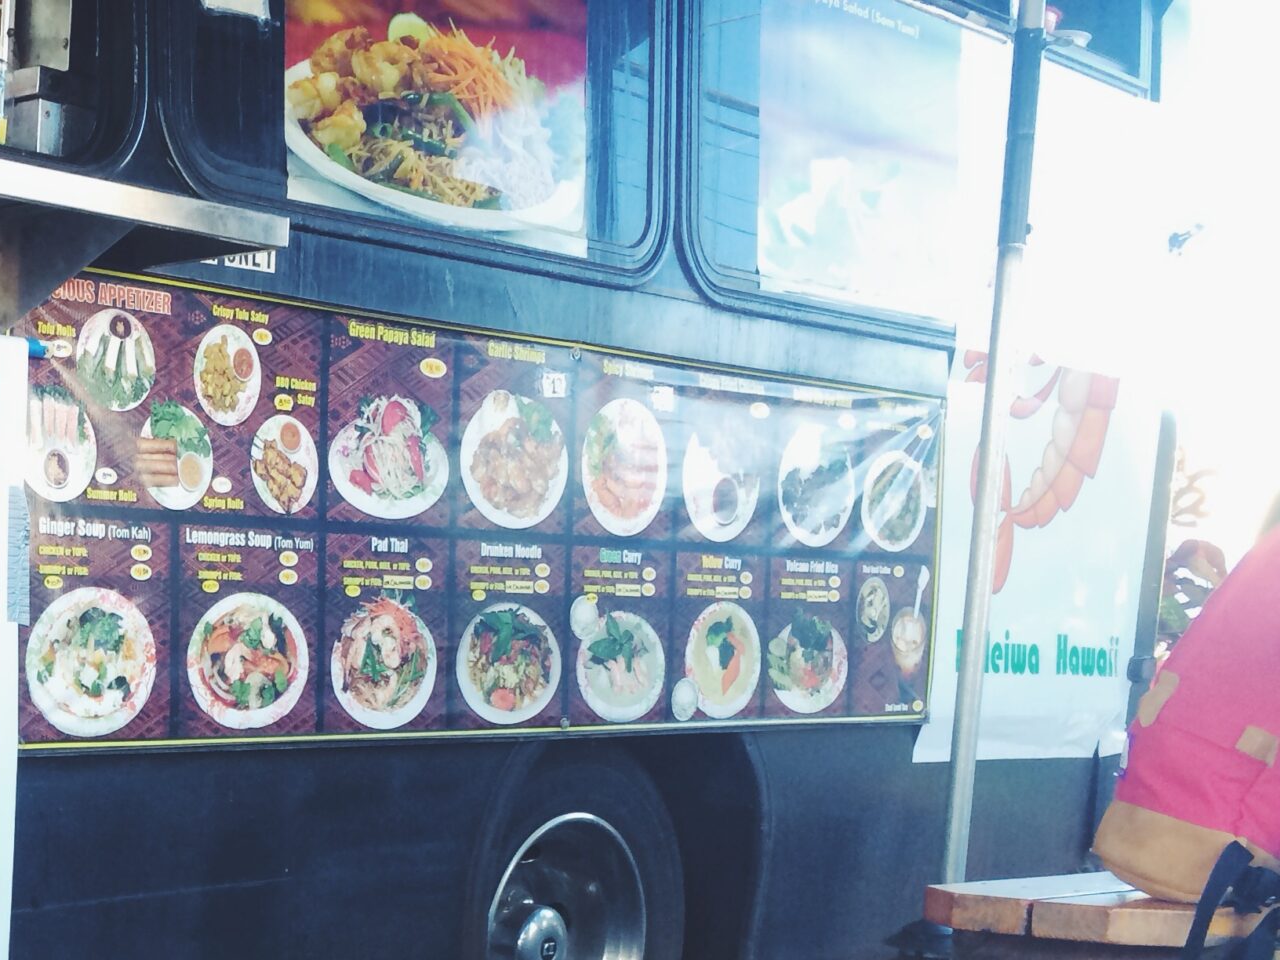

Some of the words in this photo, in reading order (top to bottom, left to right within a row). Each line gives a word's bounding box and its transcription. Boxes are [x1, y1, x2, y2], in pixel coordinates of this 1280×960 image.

[98, 282, 172, 315] APPETIZER
[212, 304, 234, 319] Crispy
[56, 323, 77, 338] Rolls
[348, 321, 376, 340] Green
[376, 323, 410, 346] Papaya
[410, 327, 436, 348] Salad
[488, 341, 512, 360] Garlic
[275, 376, 290, 389] BBQ
[290, 377, 317, 392] Chicken
[39, 516, 75, 537] Ginger
[77, 519, 106, 539] Soup
[108, 525, 130, 541] (Tom
[131, 526, 152, 542] Kah)
[186, 527, 246, 547] Lemongrass
[247, 531, 272, 549] Soup
[274, 536, 293, 551] (Tom
[294, 537, 314, 552] Yum)
[371, 536, 389, 552] Pad
[389, 537, 408, 553] Thai
[481, 542, 514, 557] Drunken
[515, 544, 542, 559] Noodle
[622, 550, 642, 565] Curry
[724, 556, 742, 570] Curry
[1056, 634, 1119, 677] Hawaii
